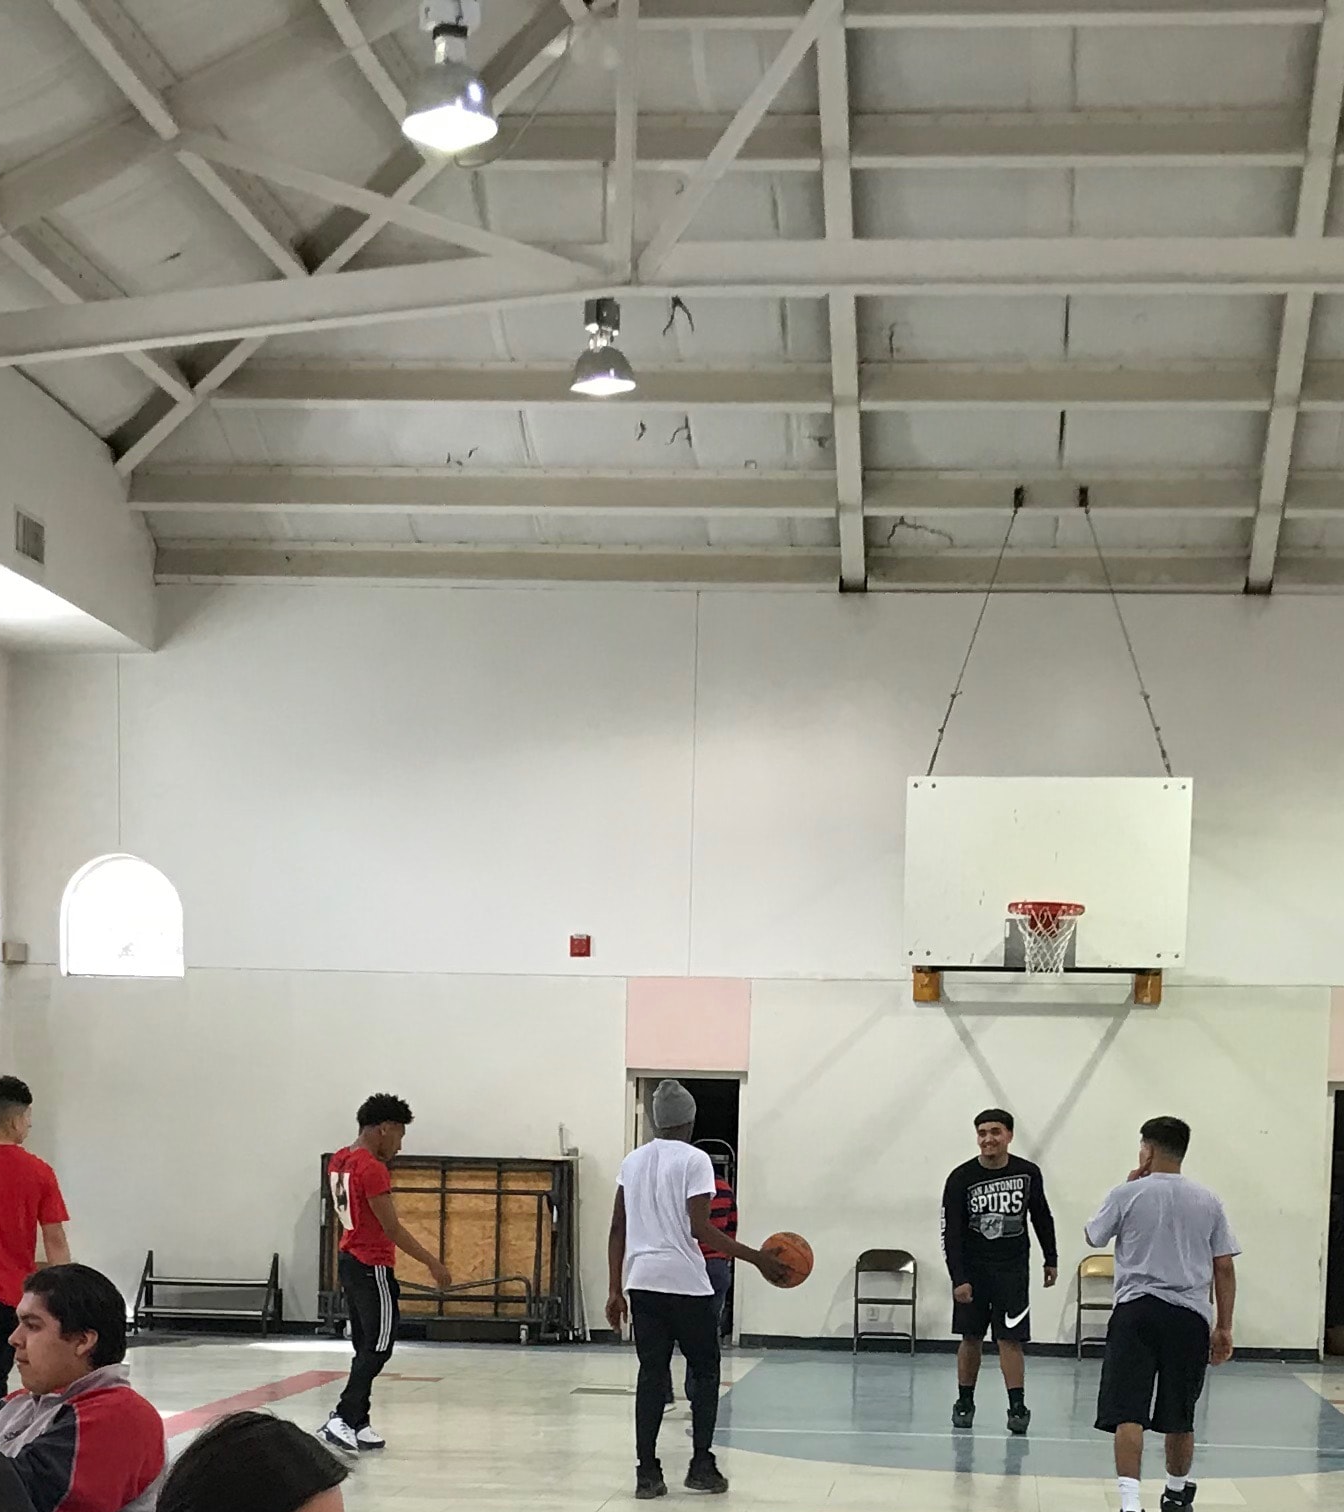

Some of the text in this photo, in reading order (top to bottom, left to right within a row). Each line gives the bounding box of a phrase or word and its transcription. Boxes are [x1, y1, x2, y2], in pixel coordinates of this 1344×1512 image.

[970, 1178, 1024, 1197] SAN ANTONIO
[970, 1191, 1024, 1213] SPURS
